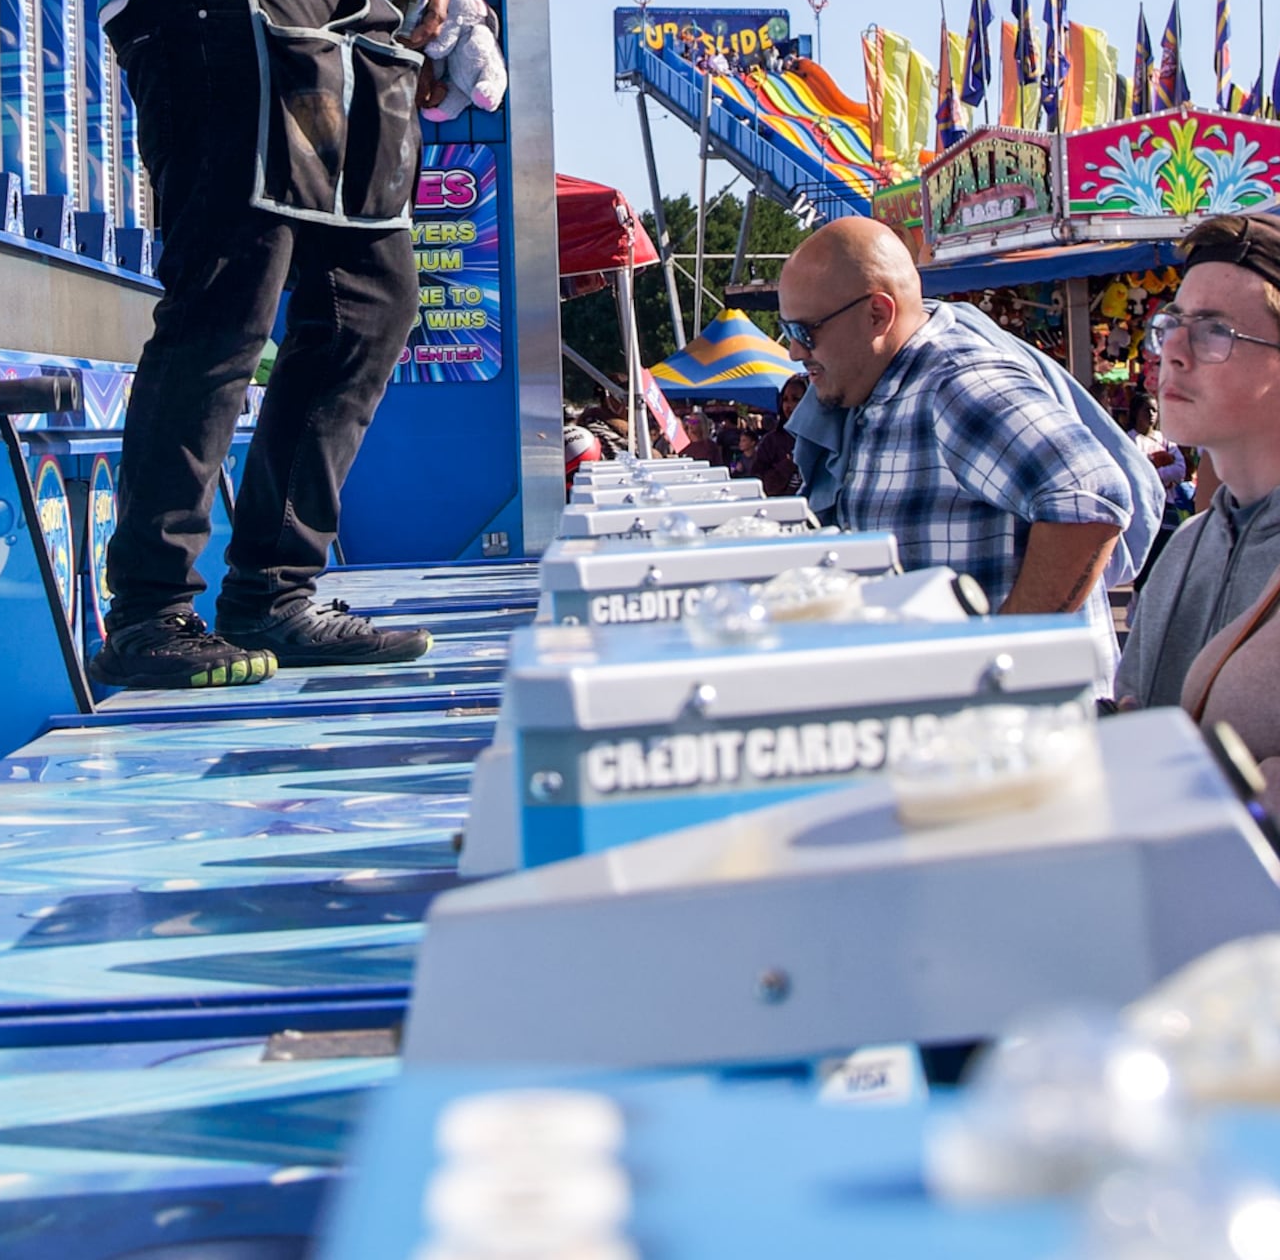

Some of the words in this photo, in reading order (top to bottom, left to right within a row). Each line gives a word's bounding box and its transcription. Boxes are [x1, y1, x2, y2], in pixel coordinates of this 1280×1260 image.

[702, 24, 773, 56] SLIDE
[416, 171, 475, 207] ES
[926, 138, 1051, 232] WATER
[451, 286, 482, 304] TO
[428, 311, 487, 328] WINS
[416, 346, 483, 361] ENTER
[591, 589, 681, 624] CREDIT
[586, 730, 742, 793] CREDIT
[746, 718, 886, 779] CARDS
